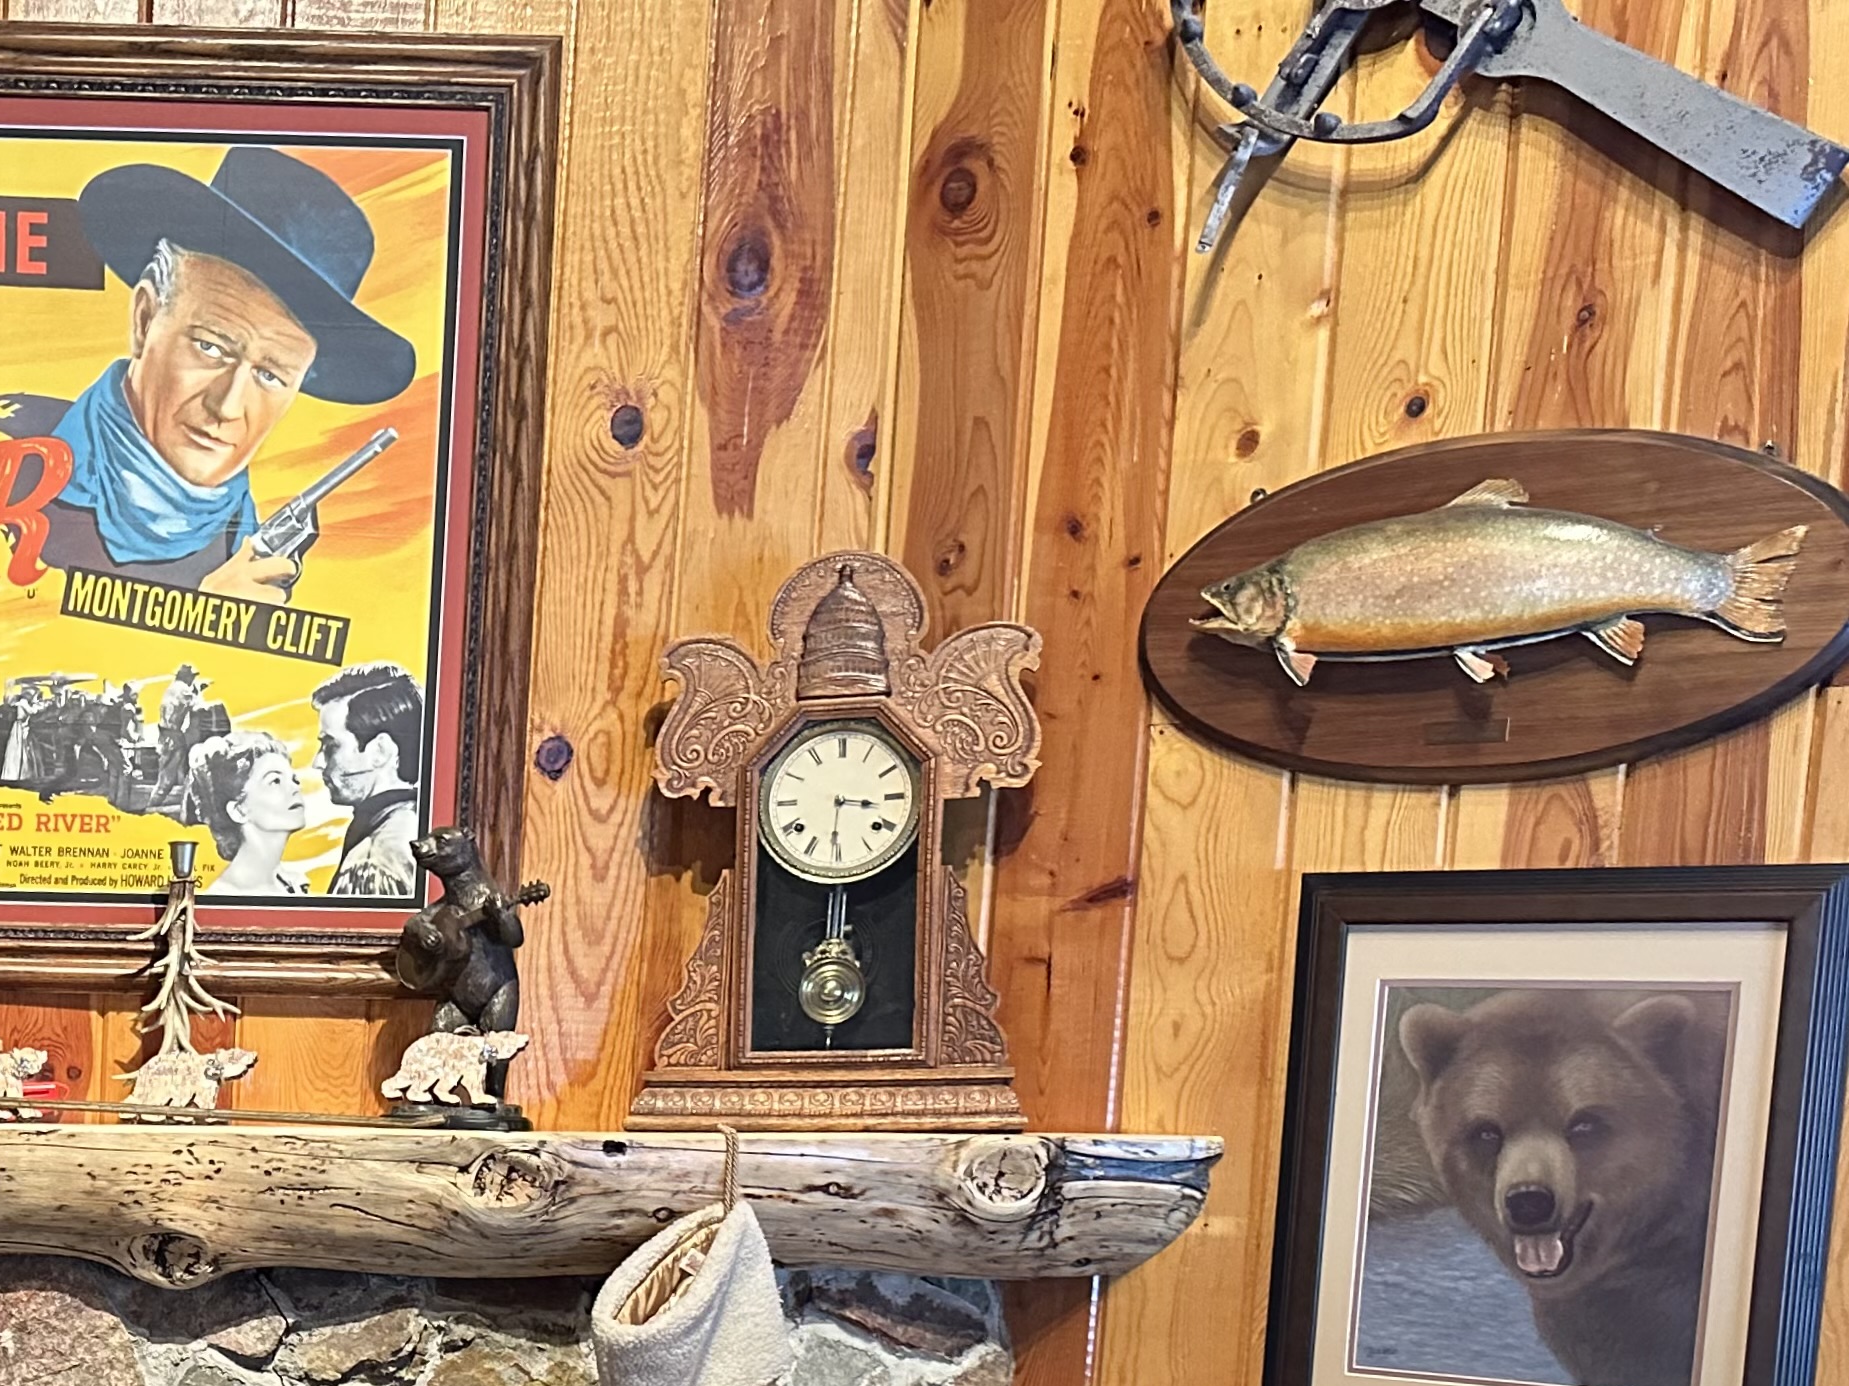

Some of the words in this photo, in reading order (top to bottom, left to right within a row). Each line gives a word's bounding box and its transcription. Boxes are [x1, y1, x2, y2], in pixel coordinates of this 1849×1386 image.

[67, 572, 257, 645] MONTGOMERY
[266, 609, 344, 660] CLIFT
[35, 813, 121, 833] RIVER"
[9, 846, 52, 857] WALTER
[57, 846, 110, 858] BRENNAN
[121, 848, 164, 859] JOANNE
[6, 860, 29, 868] NOAH
[202, 864, 215, 872] FIX
[20, 873, 52, 885] Directed
[54, 875, 68, 885] and
[71, 875, 106, 886] Produced
[109, 875, 118, 888] by
[121, 874, 164, 888] HOWARD
